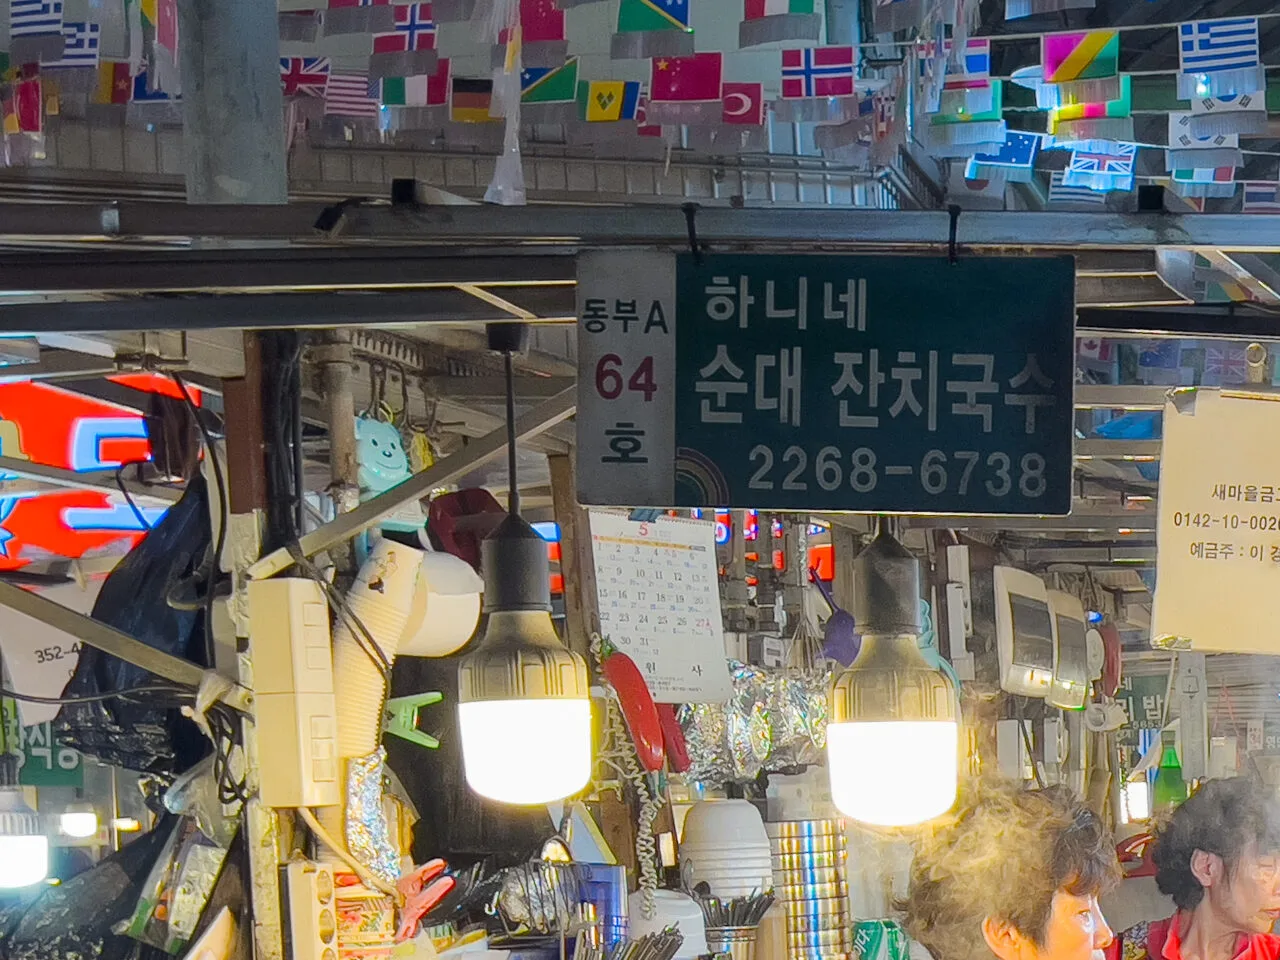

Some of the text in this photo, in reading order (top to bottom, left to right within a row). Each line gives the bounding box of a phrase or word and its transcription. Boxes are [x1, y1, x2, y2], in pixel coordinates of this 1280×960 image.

[705, 275, 867, 331] 하니네
[582, 299, 669, 334] 동부A
[595, 353, 658, 402] 64
[695, 345, 1057, 433] 순대 잔치국수
[601, 422, 649, 464] 호
[748, 445, 1047, 498] 2268-6738
[639, 522, 649, 536] 5
[616, 544, 621, 553] 2
[1190, 542, 1235, 560] 예금주
[616, 567, 622, 576] 9
[636, 568, 645, 578] 10
[655, 571, 663, 580] 11
[674, 572, 682, 581] 12
[599, 589, 608, 598] 15
[618, 590, 627, 599] 16
[637, 591, 646, 601] 17
[656, 593, 666, 602] 18
[675, 594, 685, 603] 19
[600, 612, 610, 621] 22
[619, 613, 630, 622] 23
[639, 614, 649, 624] 24
[620, 636, 649, 646] 30 31
[34, 641, 82, 664] 352-4
